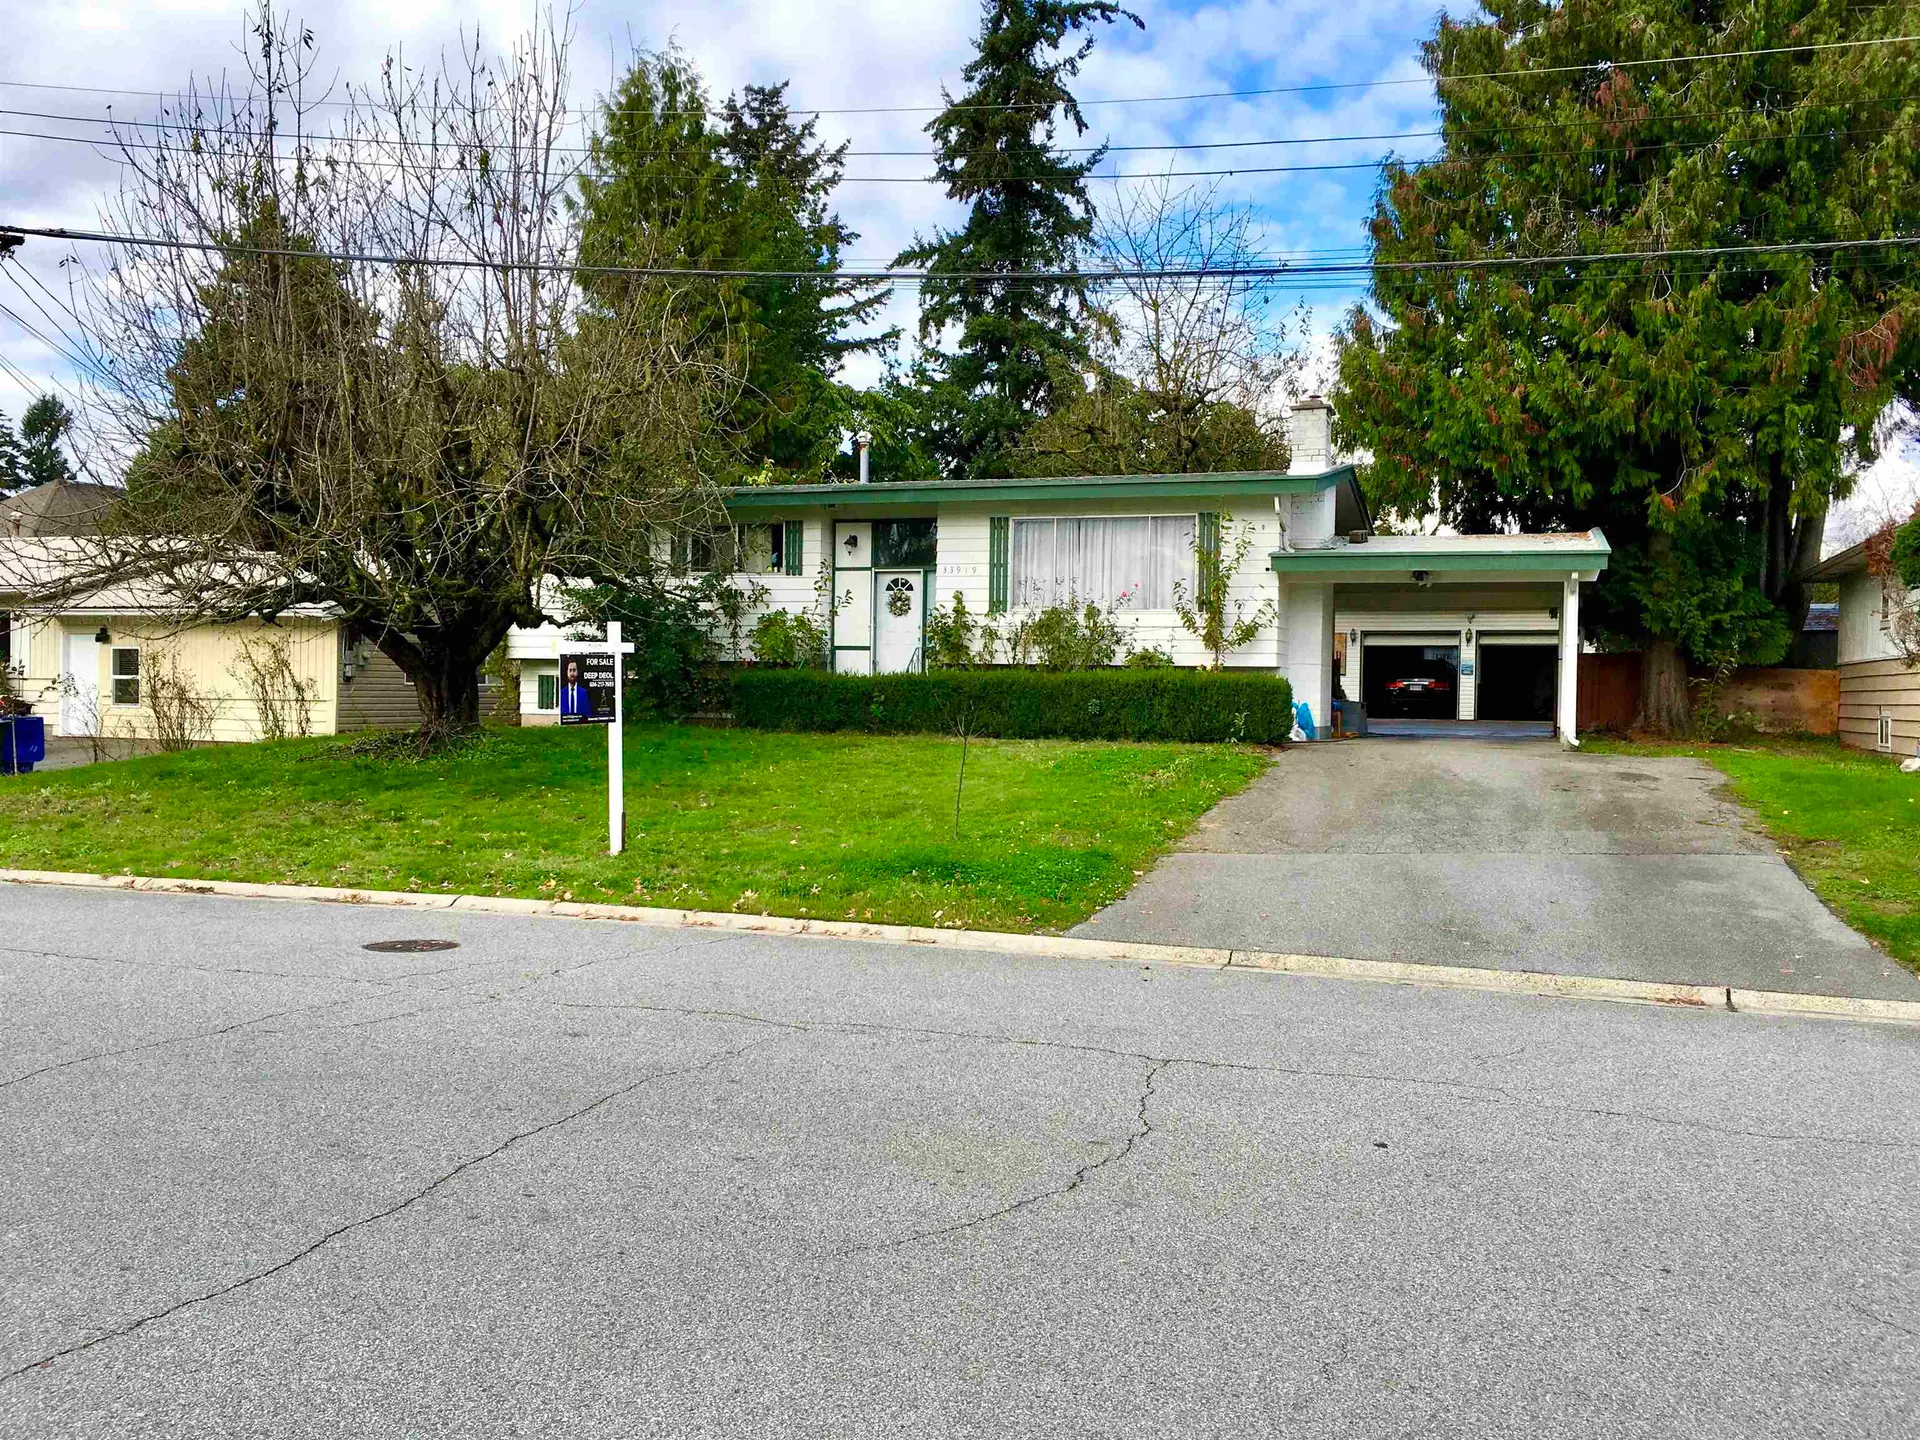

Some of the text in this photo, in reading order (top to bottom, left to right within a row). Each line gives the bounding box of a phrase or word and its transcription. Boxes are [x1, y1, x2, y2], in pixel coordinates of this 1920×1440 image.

[943, 566, 977, 574] 33919
[586, 658, 614, 666] FOR SALE
